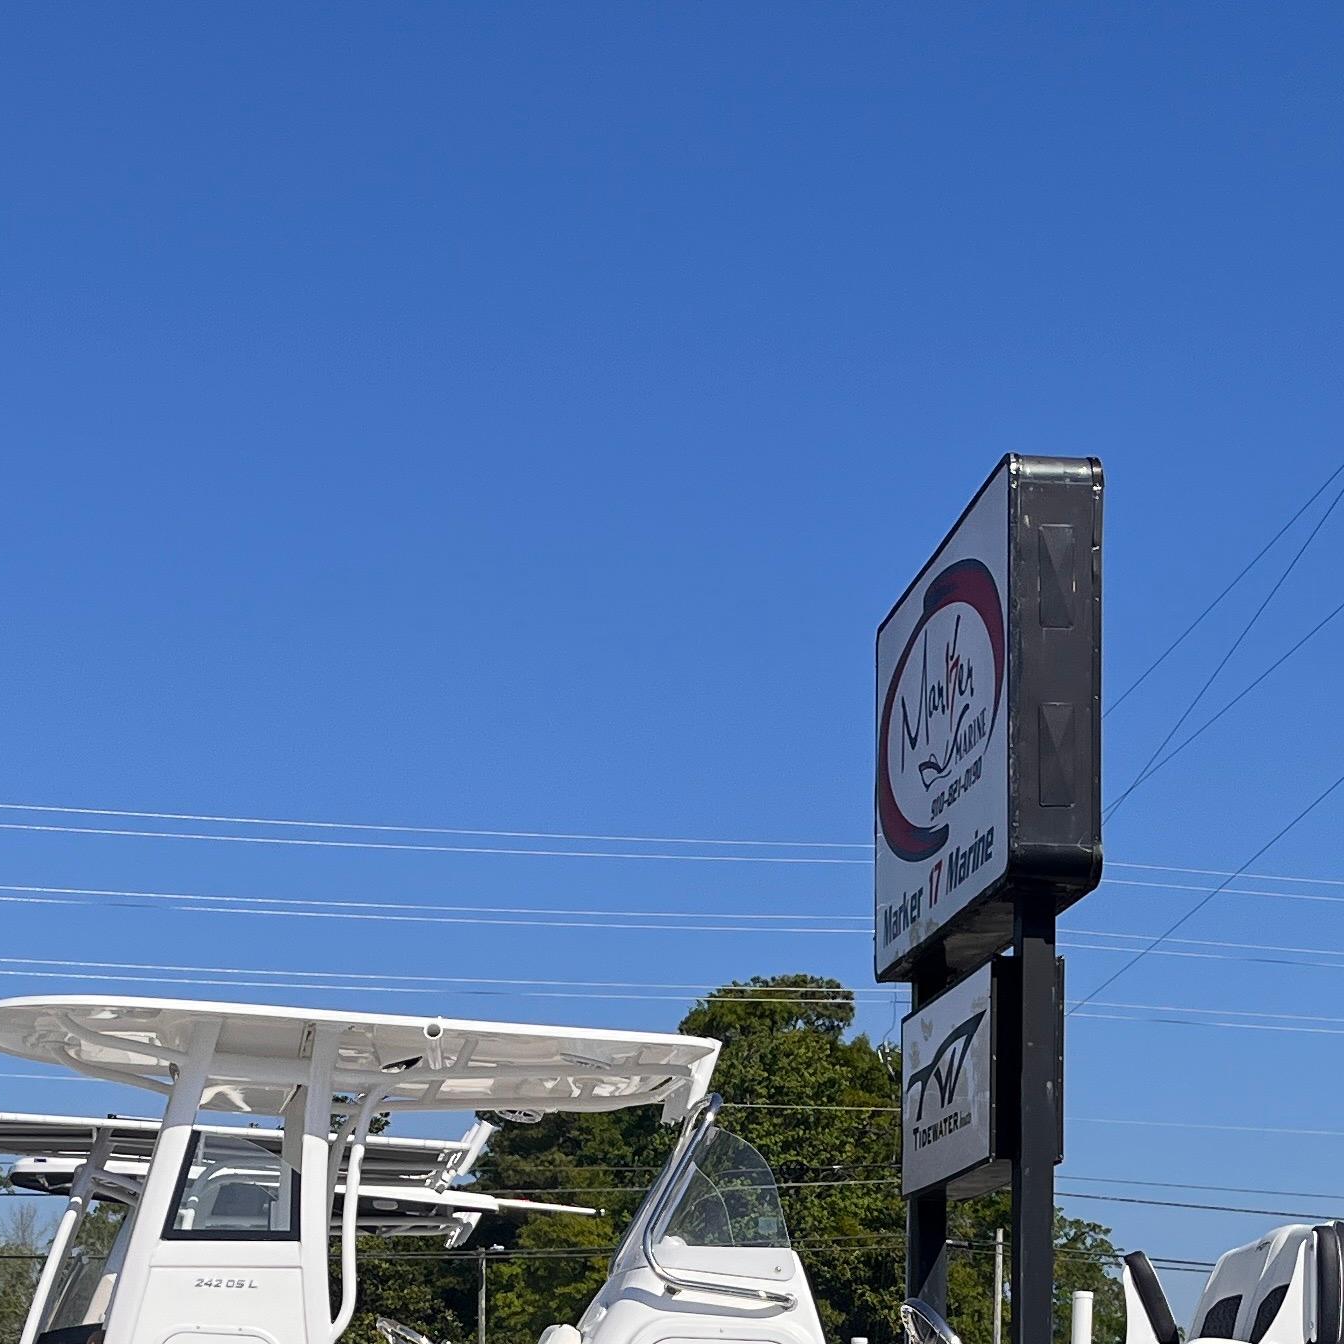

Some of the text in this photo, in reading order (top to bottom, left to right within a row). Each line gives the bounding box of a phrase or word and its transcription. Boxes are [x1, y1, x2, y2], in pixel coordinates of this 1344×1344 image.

[955, 706, 987, 766] MARINE
[883, 825, 995, 948] Marker 17 Marine
[194, 1278, 223, 1288] 242
